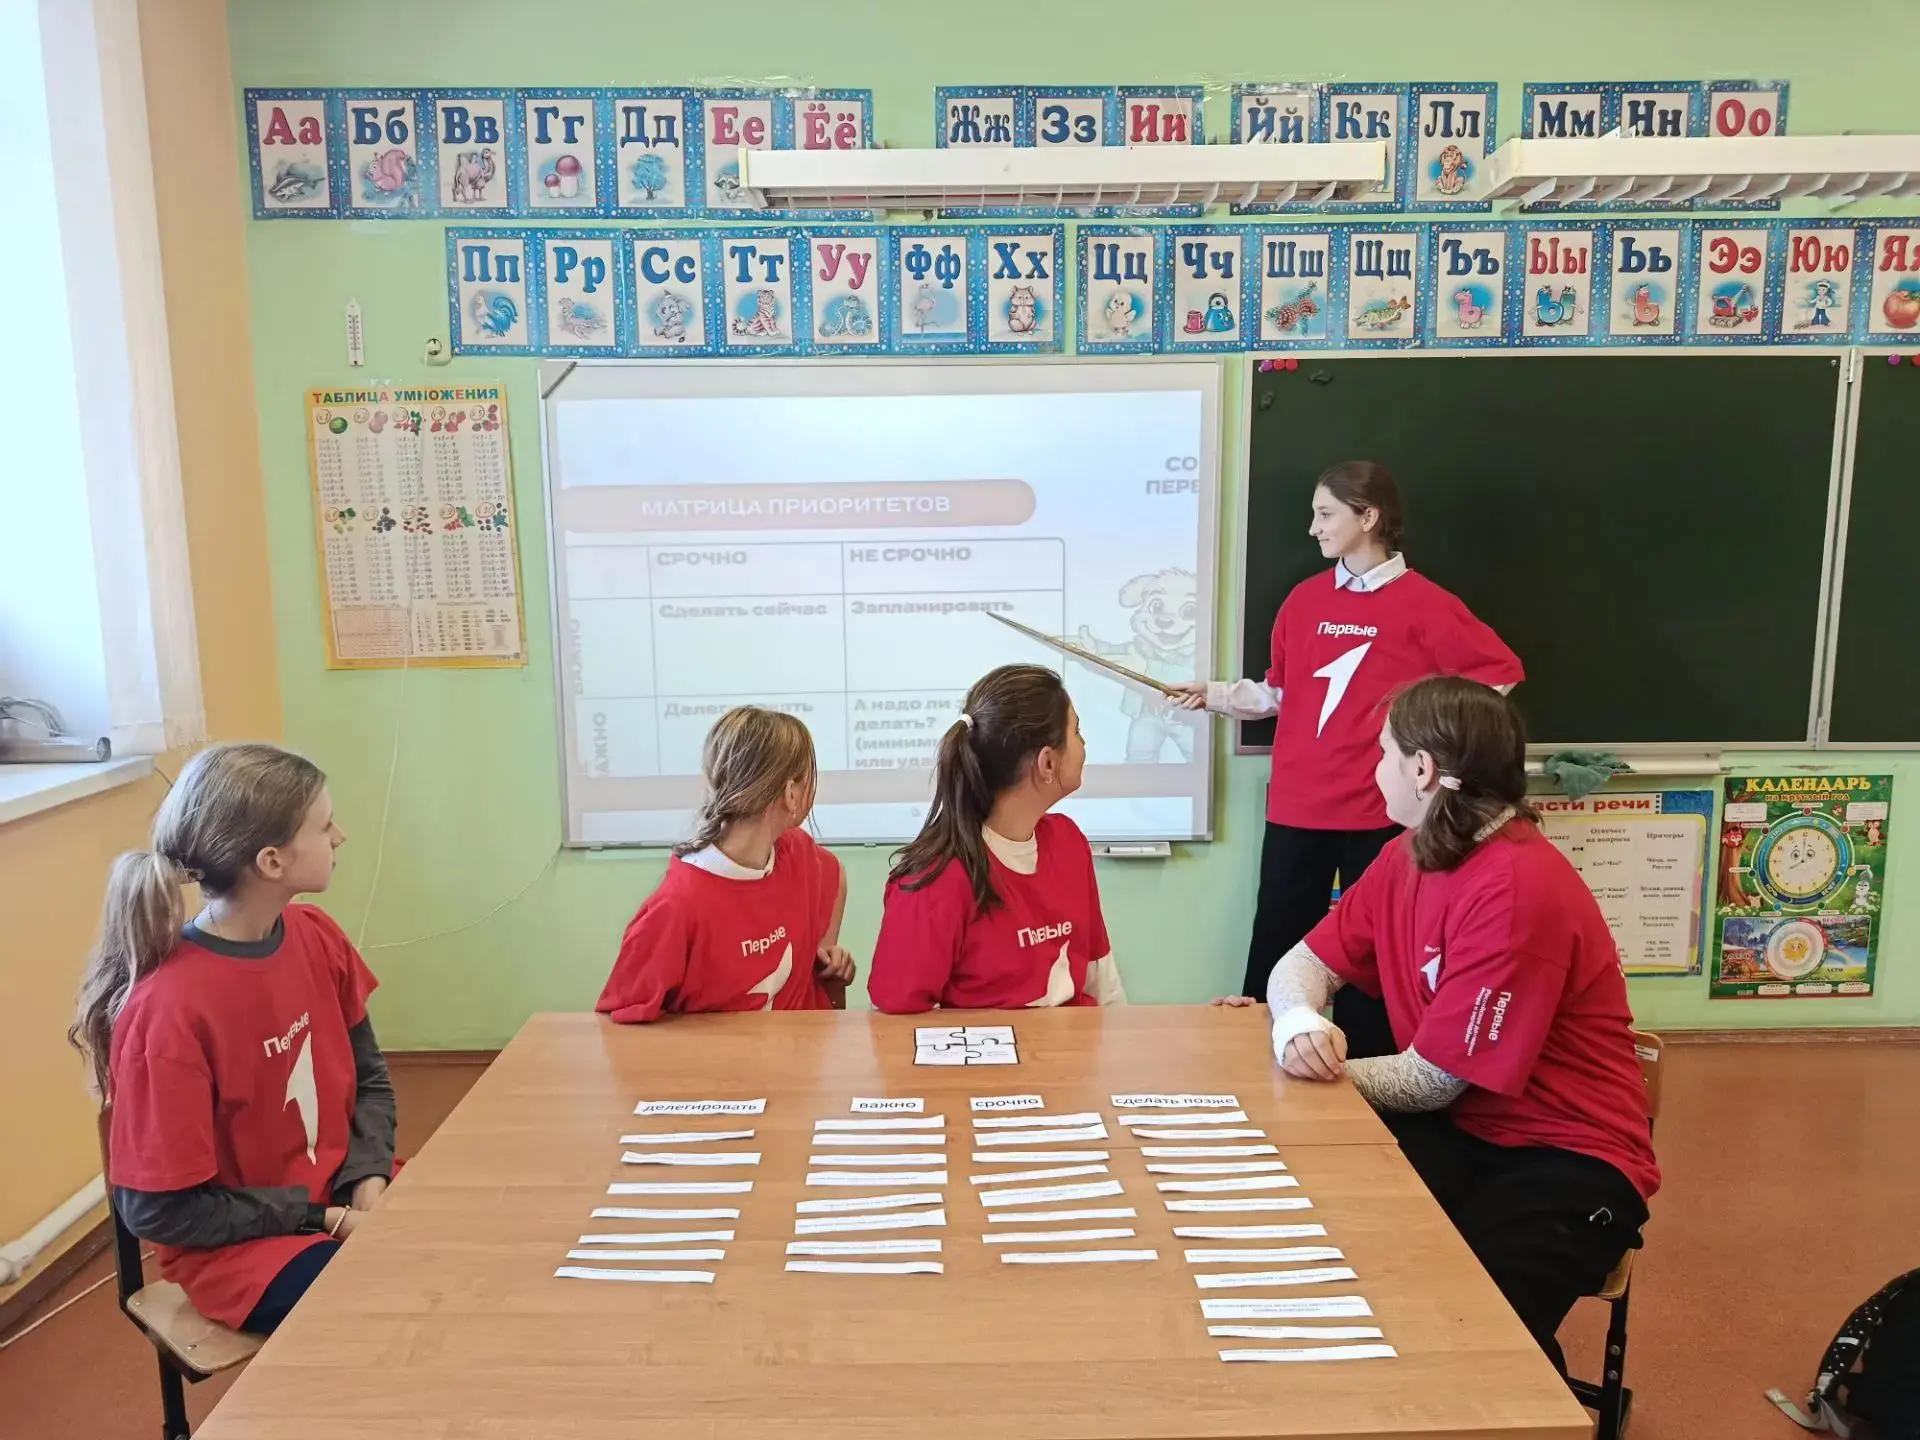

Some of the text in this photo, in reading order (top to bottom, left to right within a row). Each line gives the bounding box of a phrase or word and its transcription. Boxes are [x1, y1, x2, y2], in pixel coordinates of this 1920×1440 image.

[263, 102, 857, 149] Аа Бб Вв Гг Дд Ее Ёё
[949, 104, 1187, 143] Жж Зз Ии
[1247, 97, 1481, 143] Йй Кк Лл
[1538, 98, 1771, 138] Мм Нн Оо
[461, 242, 1049, 292] Пп Рр Сс Тт Уу Фф Хх
[1093, 243, 1148, 284] Цц
[1181, 243, 1235, 278] Чч
[1266, 241, 1324, 278] Шш
[1354, 240, 1412, 281] Щщ
[1442, 238, 1500, 275] Ъъ
[1530, 237, 1588, 275] Ыы
[1618, 236, 1673, 274] Ьь
[1708, 236, 1763, 274] Ээ
[1791, 235, 1850, 273] Юю
[312, 388, 499, 404] ТАБЛИЦА УМНОЖЕНИЯ
[641, 496, 951, 517] МАТРИЦА ПРИОРИТЕТОВ
[656, 551, 748, 566] СРОЧНО
[850, 547, 971, 562] НЕ СРОЧНО
[658, 602, 829, 619] Сделать сейчас
[850, 600, 1014, 615] Запланировать
[1317, 621, 1378, 638] Первые
[854, 699, 868, 711] А
[871, 699, 923, 712] надо
[924, 699, 950, 710] ли
[853, 717, 937, 732] делать?
[592, 712, 609, 776] АЖНО
[1745, 777, 1872, 792] КАЛЕНДАРЬ
[1531, 800, 1650, 812] асти речи
[741, 926, 786, 957] Перые
[1017, 921, 1072, 948] Пвые
[1488, 991, 1512, 1041] Первые
[643, 1103, 757, 1112] делегировать
[859, 1101, 917, 1109] важно
[975, 1098, 1040, 1108] срочно
[1115, 1097, 1235, 1105] сделать позже
